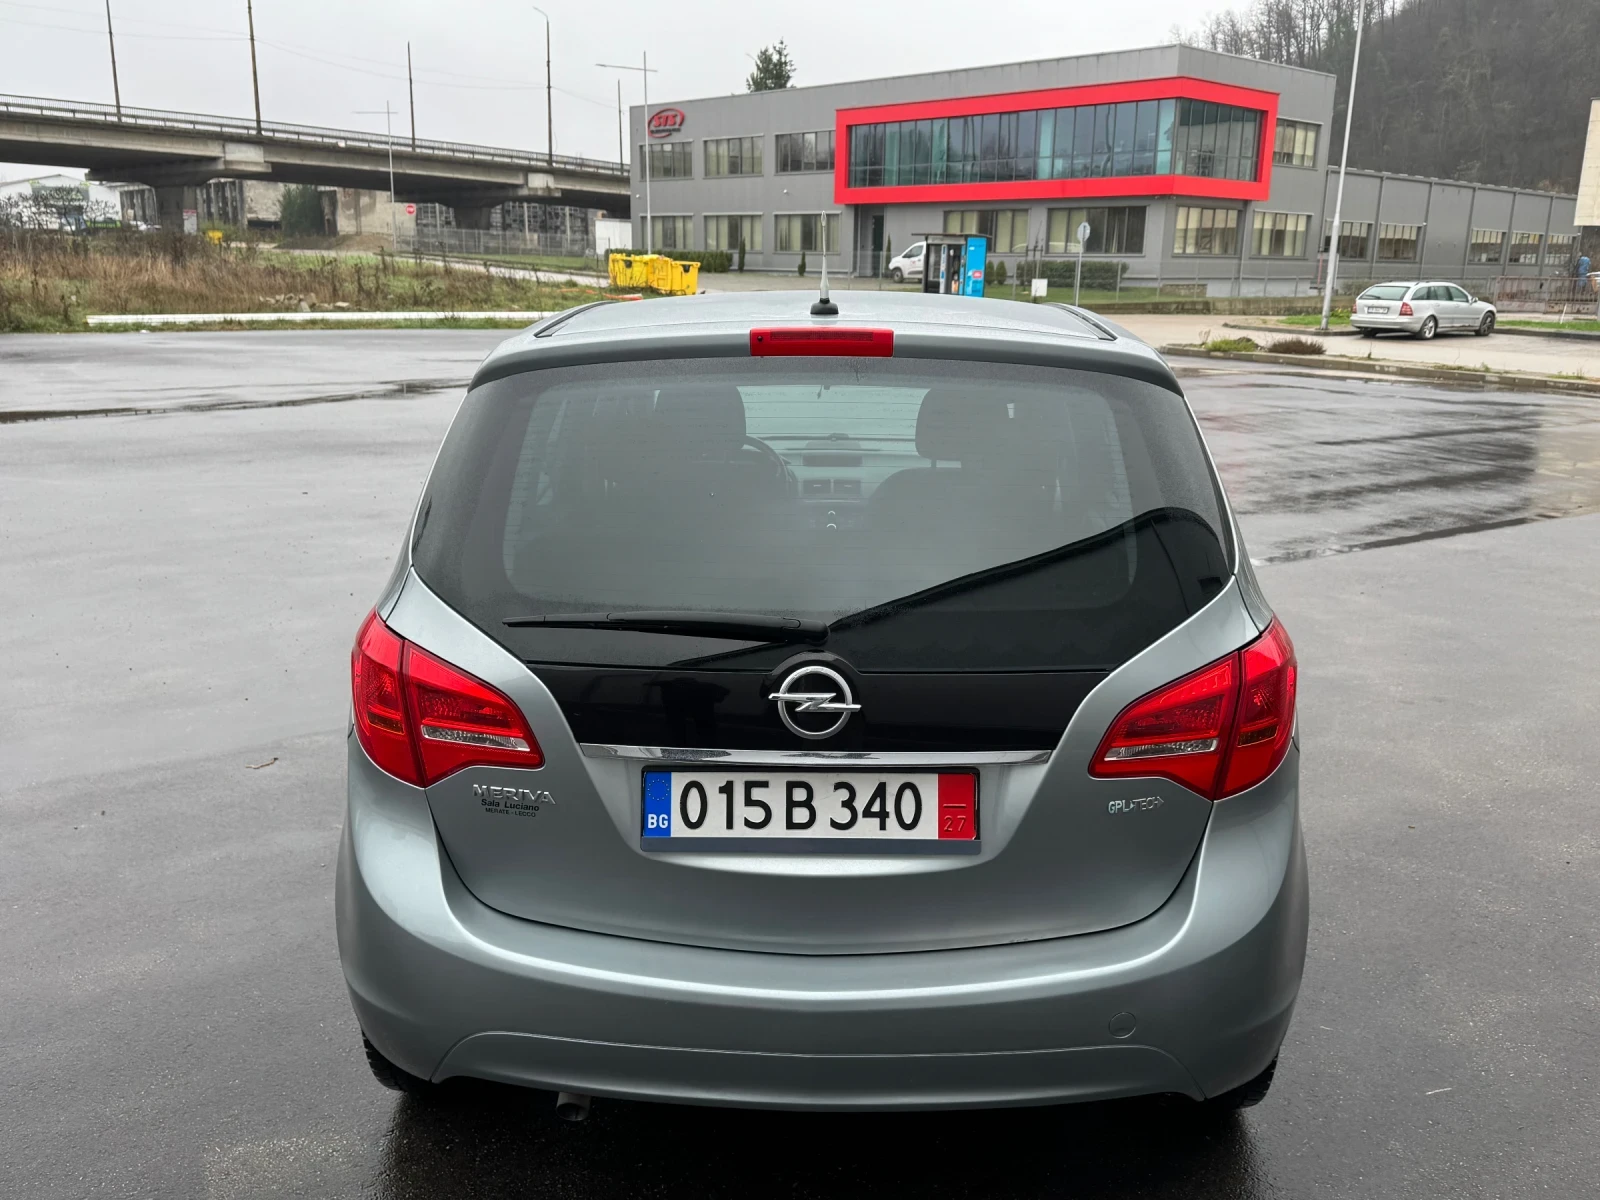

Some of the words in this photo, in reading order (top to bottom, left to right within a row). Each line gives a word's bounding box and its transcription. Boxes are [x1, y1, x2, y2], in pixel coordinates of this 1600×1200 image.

[472, 783, 557, 805] MERIVA
[480, 798, 500, 808] Sala
[504, 800, 540, 812] Luciano
[485, 807, 510, 815] MERATE
[515, 810, 536, 818] LECCO
[647, 813, 669, 829] BG
[943, 815, 967, 832] 27
